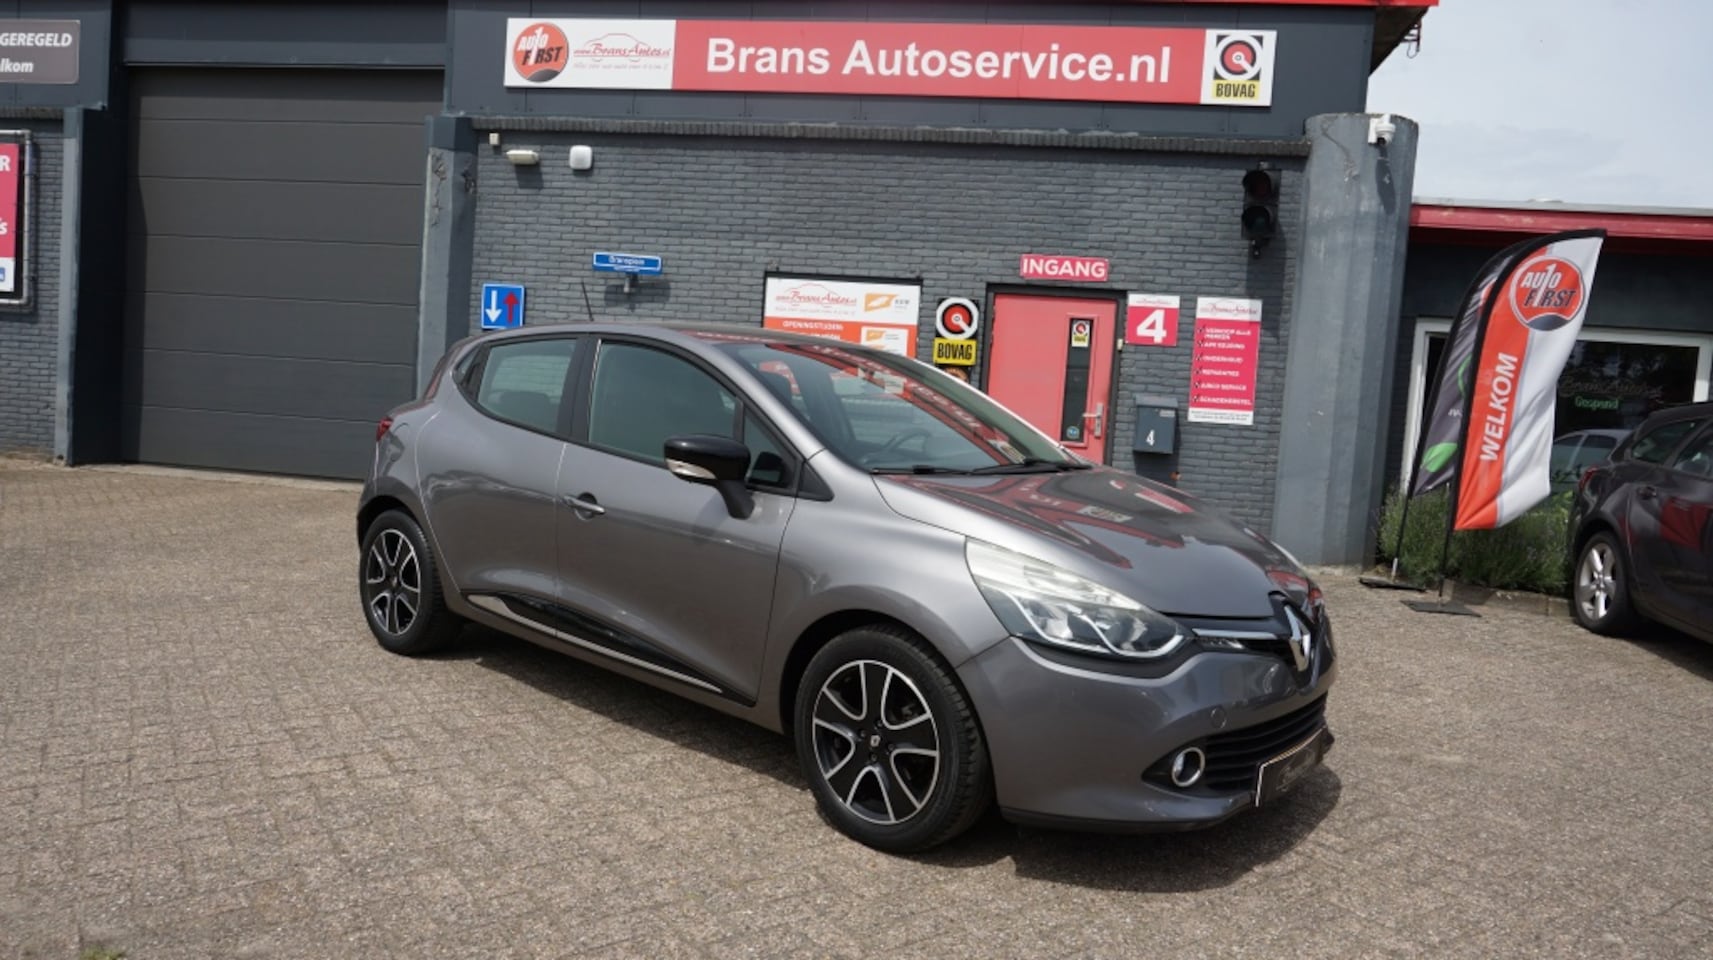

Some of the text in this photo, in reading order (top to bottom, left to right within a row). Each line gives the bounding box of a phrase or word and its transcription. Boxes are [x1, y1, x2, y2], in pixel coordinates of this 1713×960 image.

[0, 32, 73, 47] GEREGELD
[0, 57, 34, 73] lkom
[522, 46, 563, 66] FIRST
[707, 37, 1171, 83] Brans Autoservice.nl
[1216, 83, 1256, 98] BOVAG
[1022, 257, 1107, 279] INGANG
[1520, 263, 1562, 289] AUTO
[1523, 288, 1577, 308] FIRST
[1136, 309, 1167, 344] 4
[937, 342, 973, 360] BOVAG
[1480, 352, 1518, 462] WELKOM
[1146, 429, 1155, 446] 4
